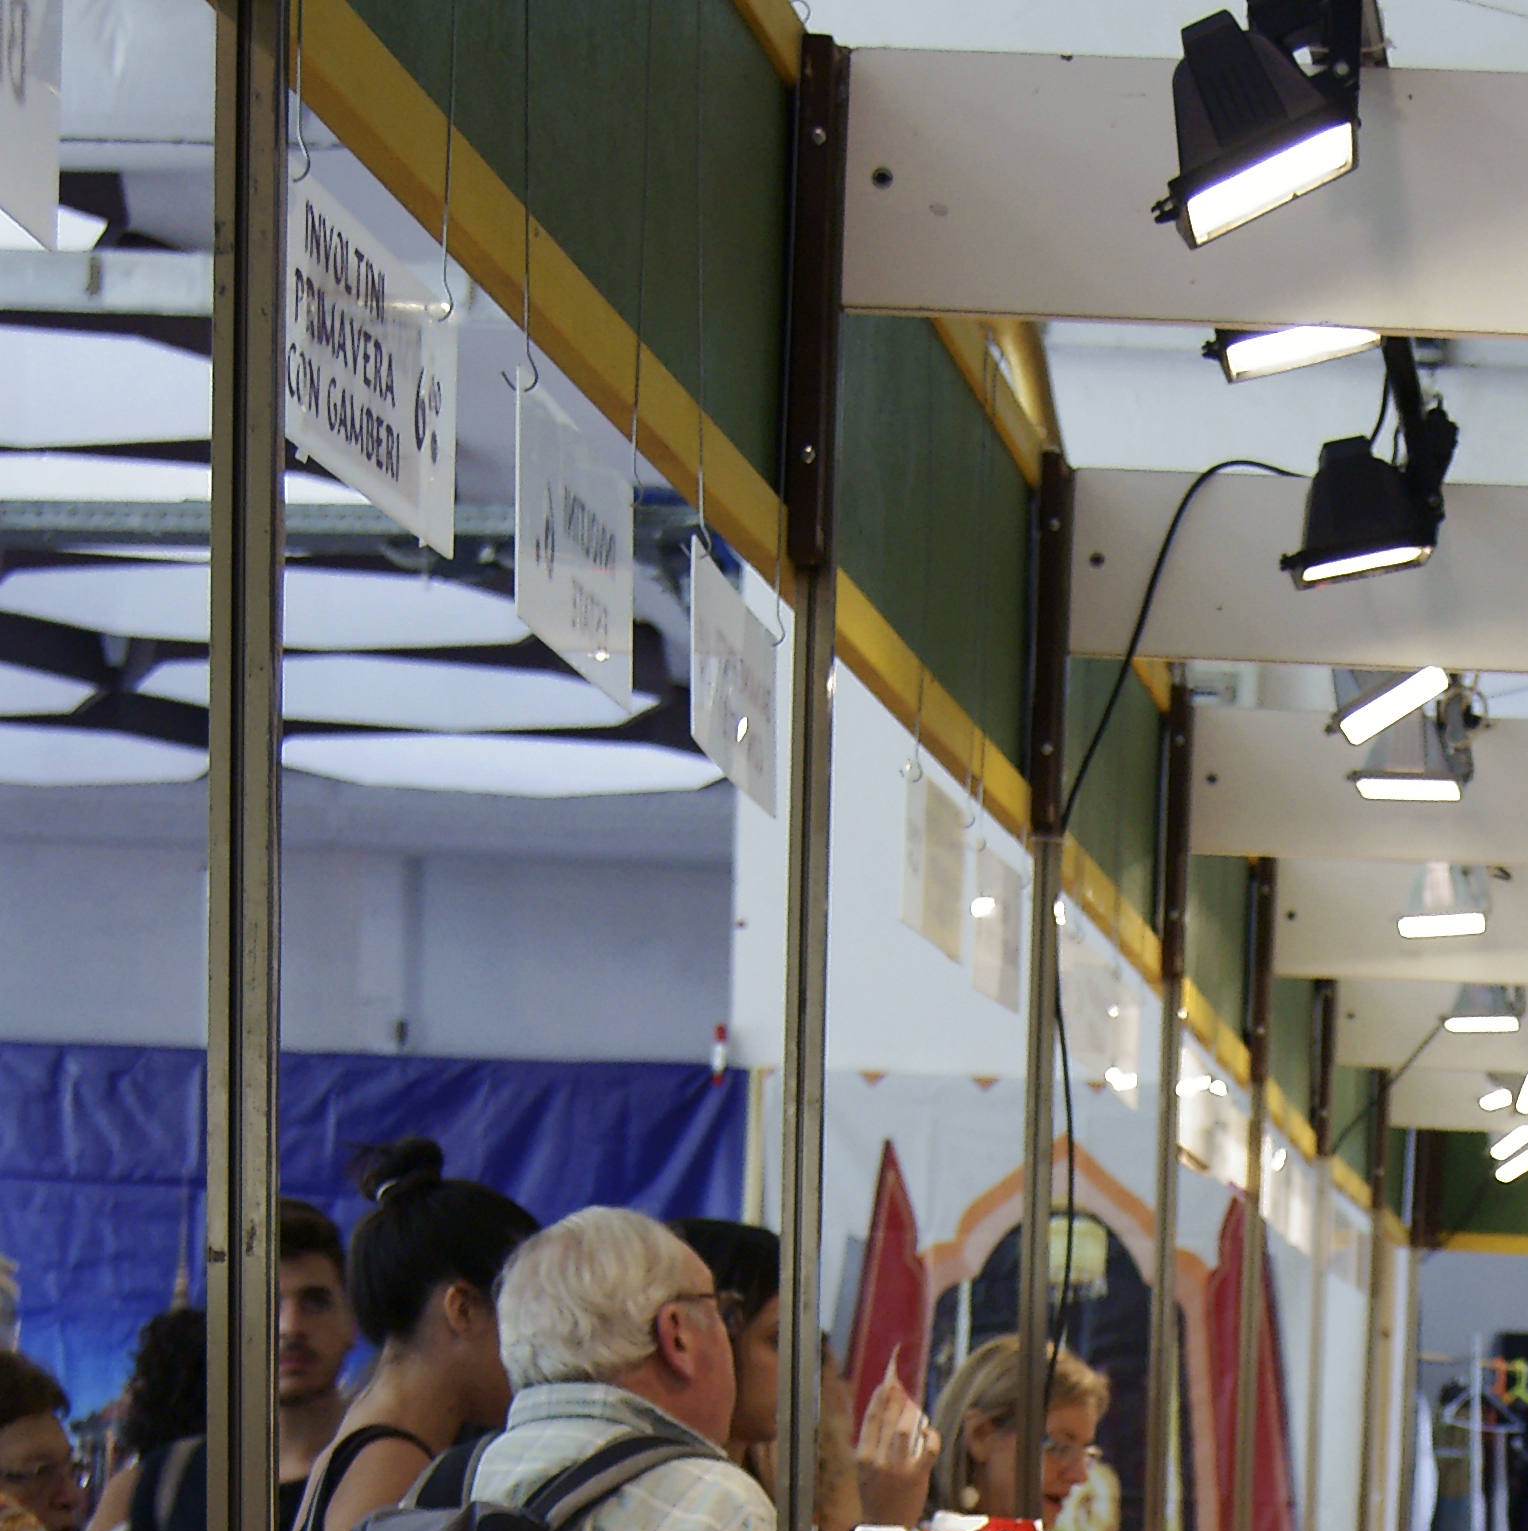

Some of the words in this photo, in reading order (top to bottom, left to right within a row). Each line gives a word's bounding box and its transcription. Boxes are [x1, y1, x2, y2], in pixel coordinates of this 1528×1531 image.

[304, 199, 386, 324] INVOLTINI
[294, 266, 396, 409] PRIMAVERA
[287, 342, 321, 419] CON
[327, 376, 401, 482] GAMBERI
